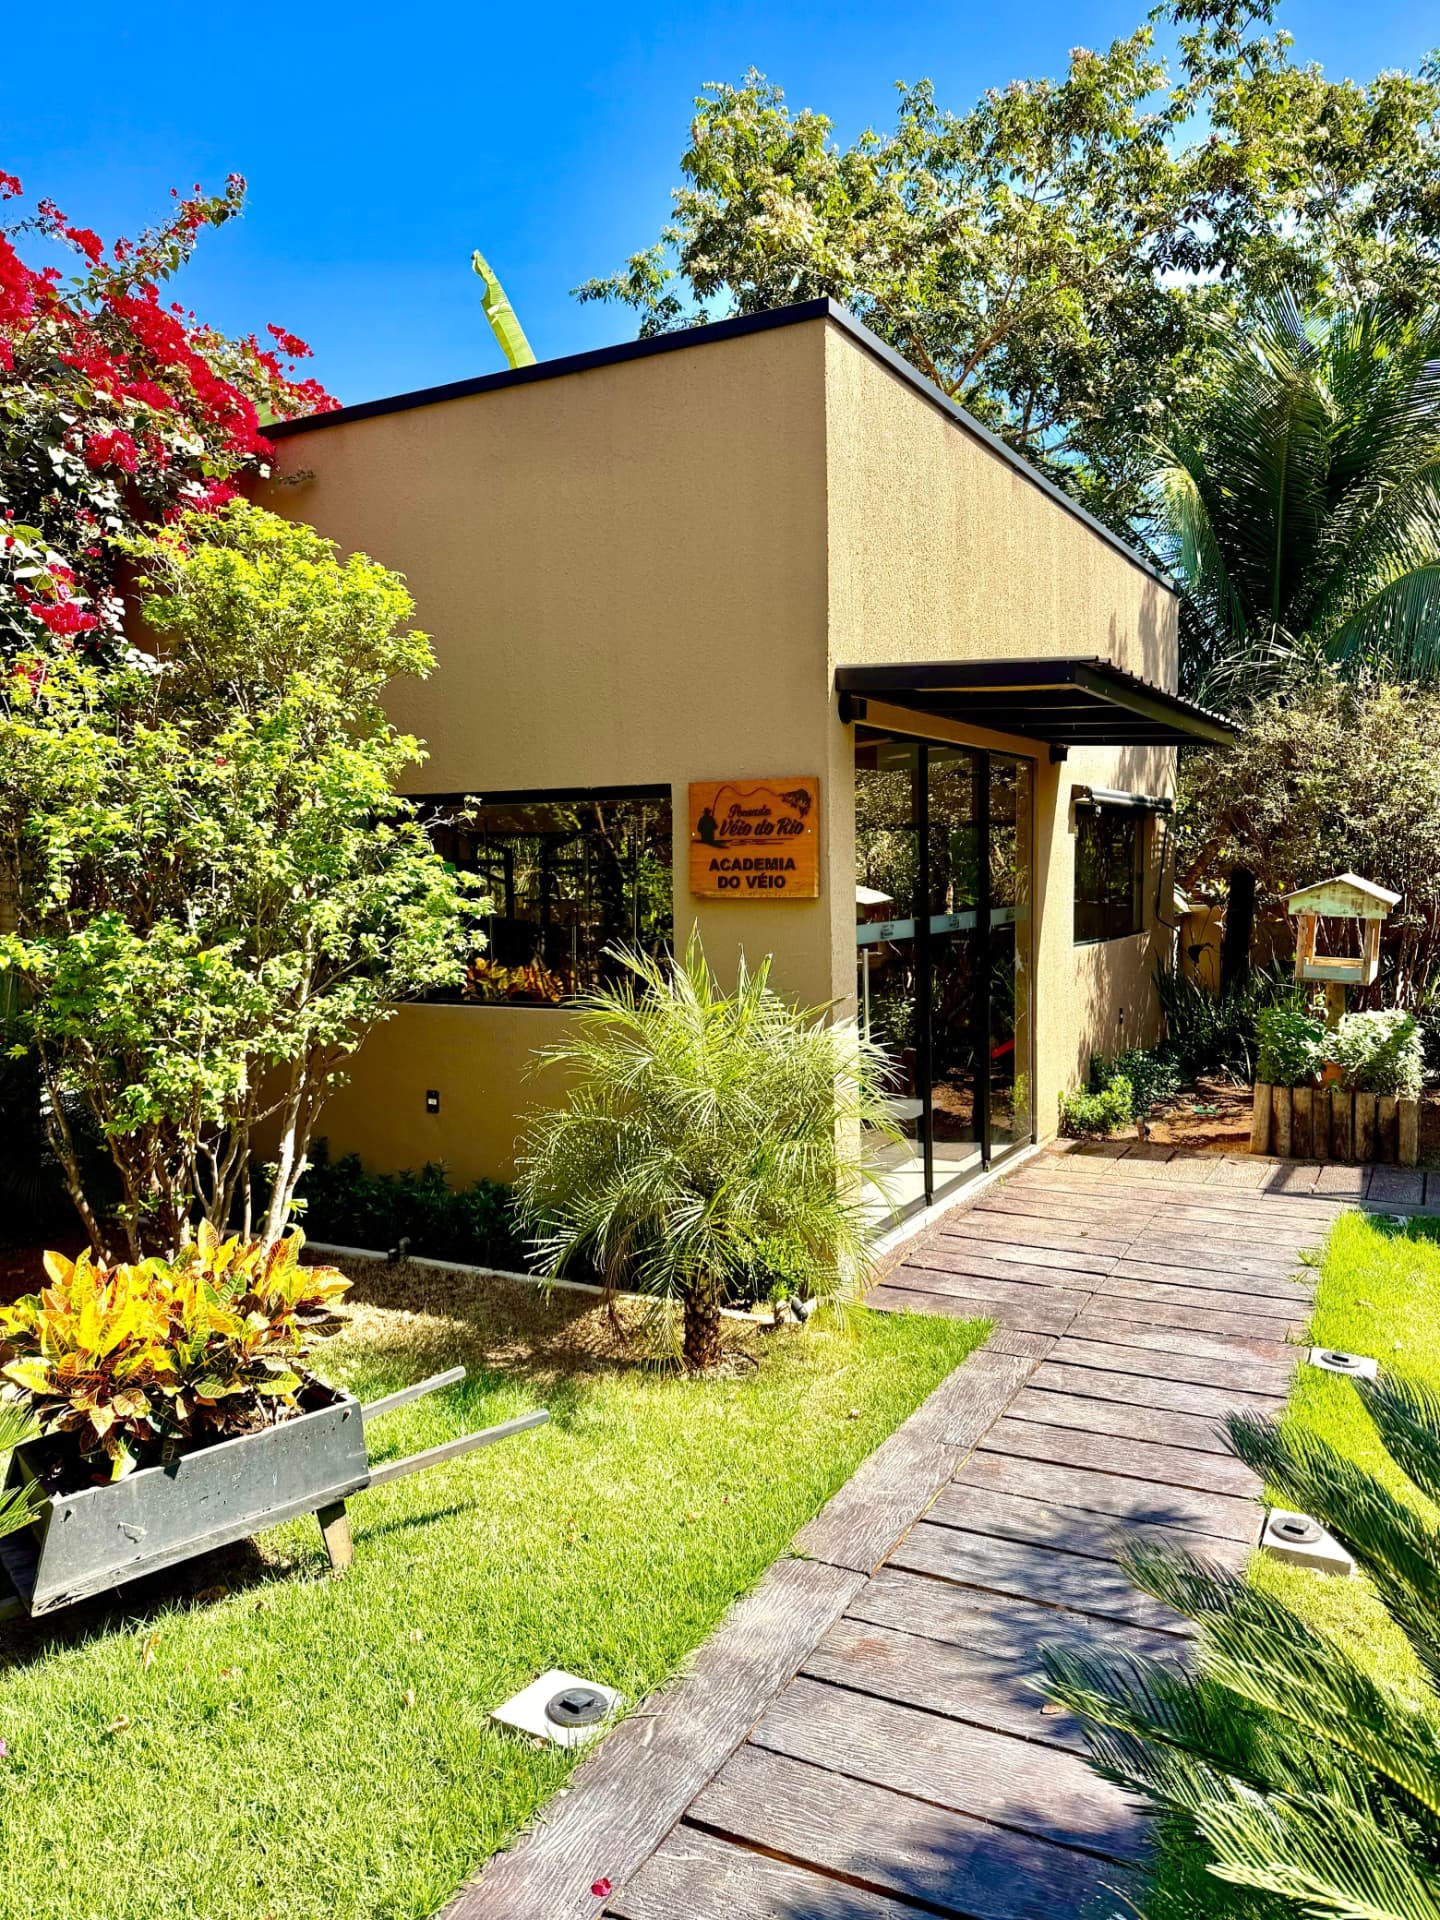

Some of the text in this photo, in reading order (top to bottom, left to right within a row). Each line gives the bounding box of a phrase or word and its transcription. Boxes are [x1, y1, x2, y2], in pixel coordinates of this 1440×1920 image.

[719, 817, 804, 836] Véio do Rio
[709, 857, 796, 871] ACADEMIA
[717, 872, 786, 889] DO VÉIO
